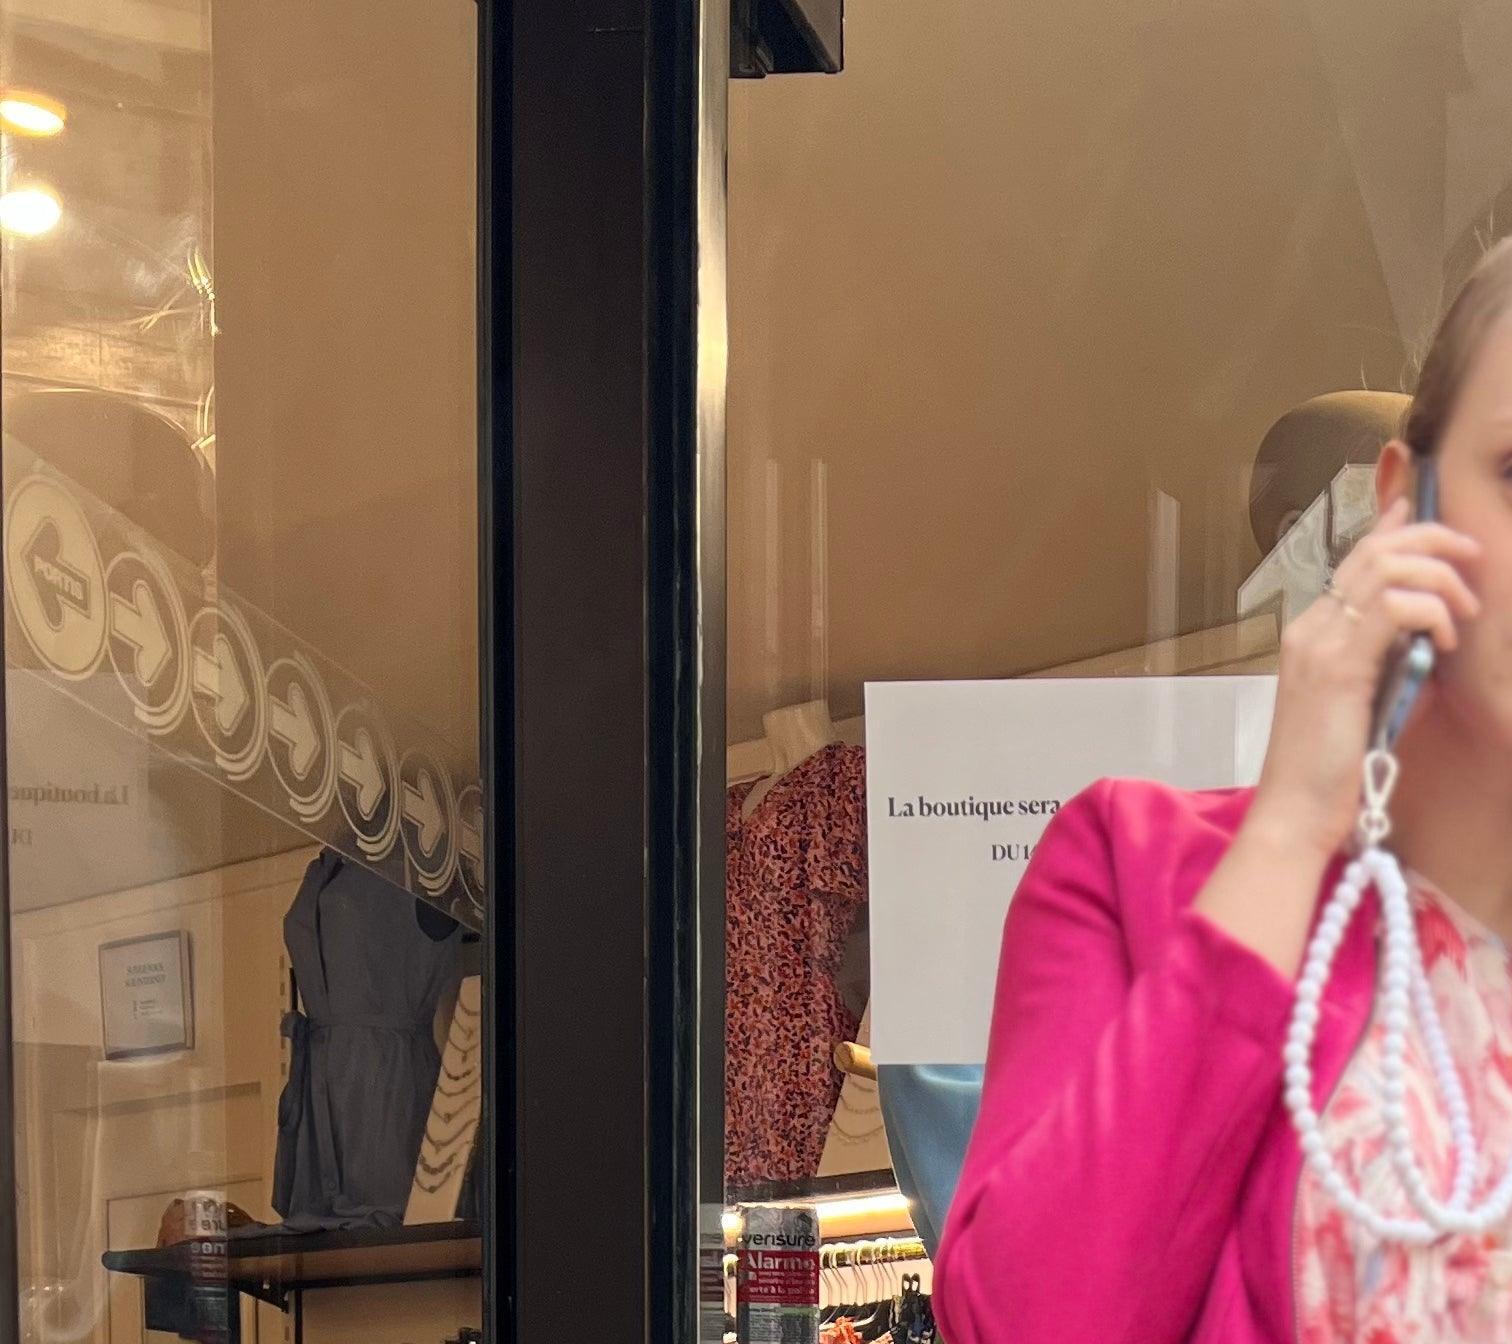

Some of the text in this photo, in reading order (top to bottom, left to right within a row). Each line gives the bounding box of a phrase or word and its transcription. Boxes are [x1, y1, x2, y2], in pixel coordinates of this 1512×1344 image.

[888, 796, 1060, 821] La boutique sera
[992, 844, 1021, 861] DU
[743, 1233, 815, 1247] verisure
